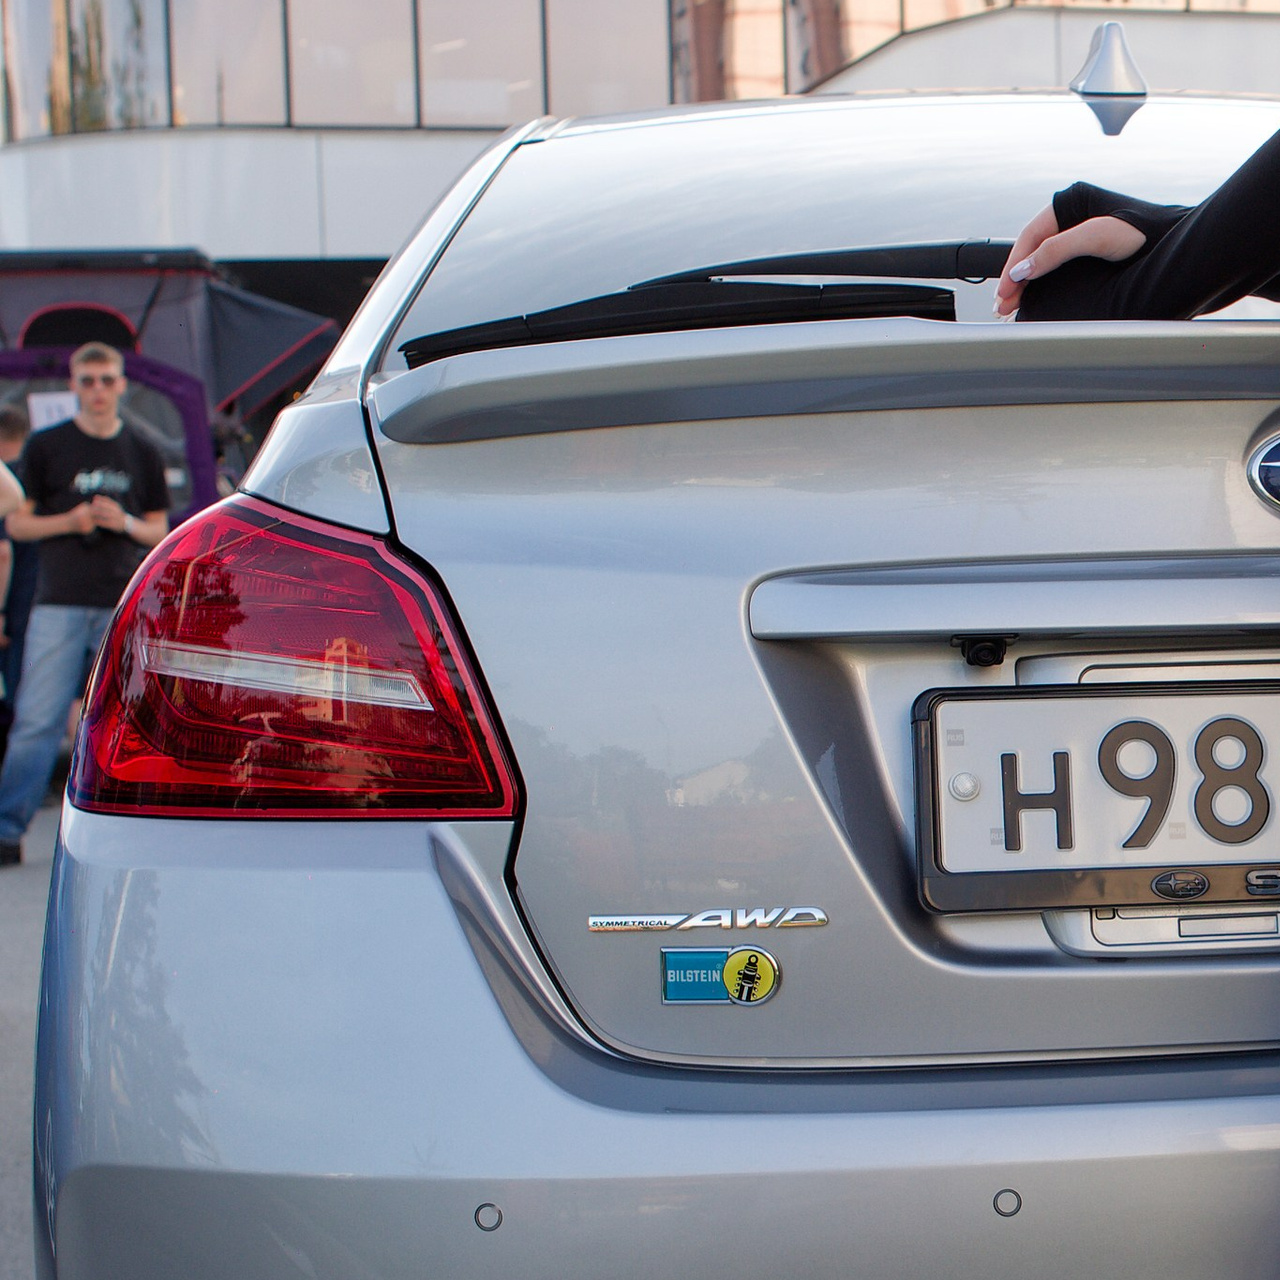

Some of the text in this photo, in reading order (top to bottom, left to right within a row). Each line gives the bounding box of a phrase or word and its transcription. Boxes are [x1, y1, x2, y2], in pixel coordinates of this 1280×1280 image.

[591, 906, 829, 931] SYMMETRICAL AWD
[667, 969, 721, 982] BILSTEIN
